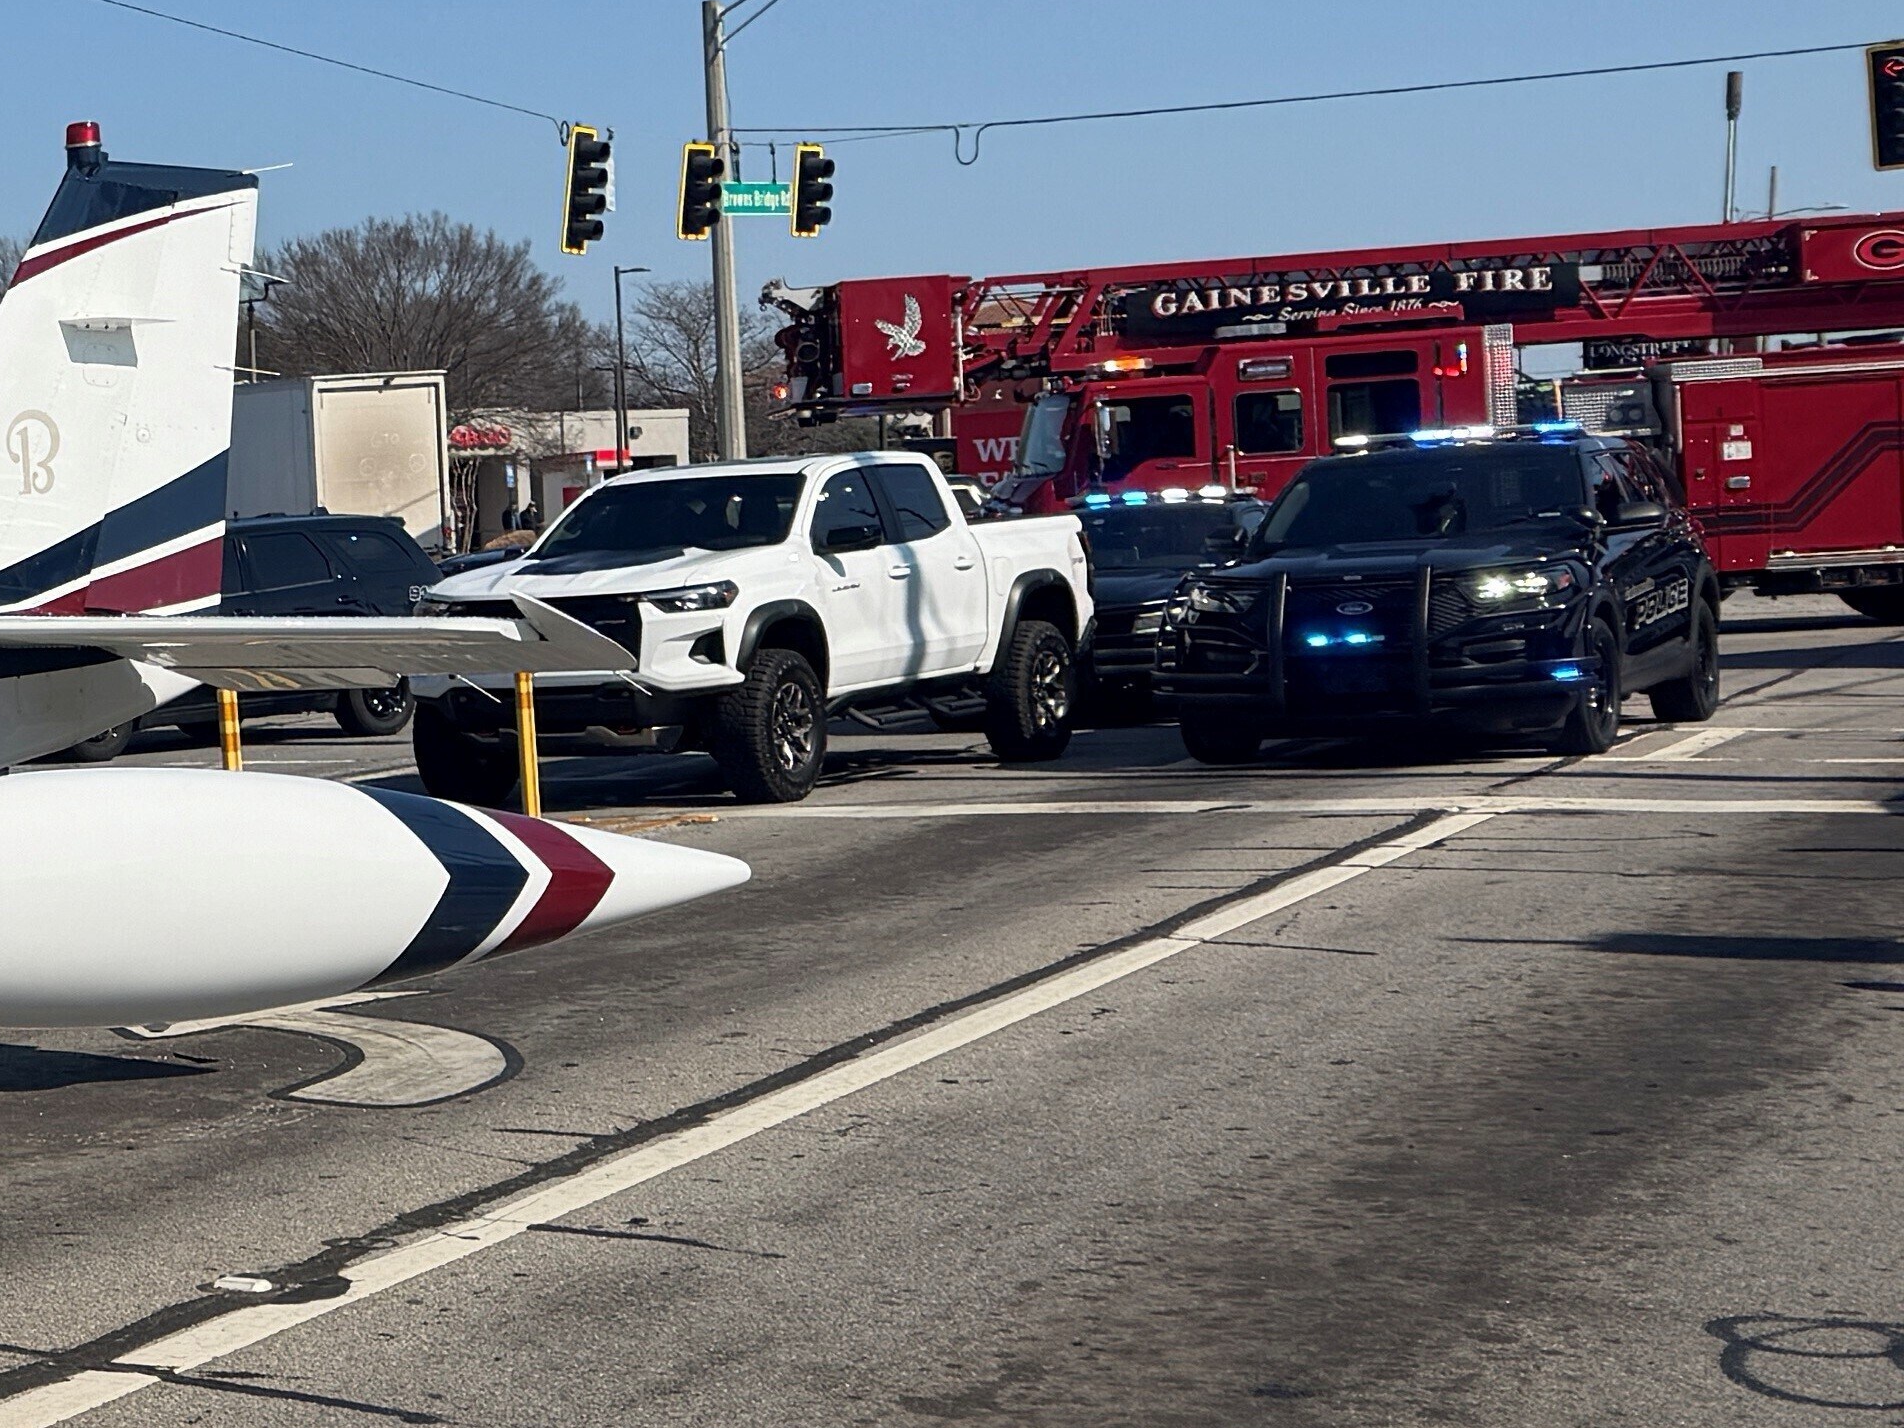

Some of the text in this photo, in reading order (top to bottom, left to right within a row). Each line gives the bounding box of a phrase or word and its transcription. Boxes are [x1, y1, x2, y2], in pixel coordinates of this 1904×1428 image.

[753, 189, 779, 211] Bridge
[1151, 267, 1553, 318] GAINESVILLE FIRE
